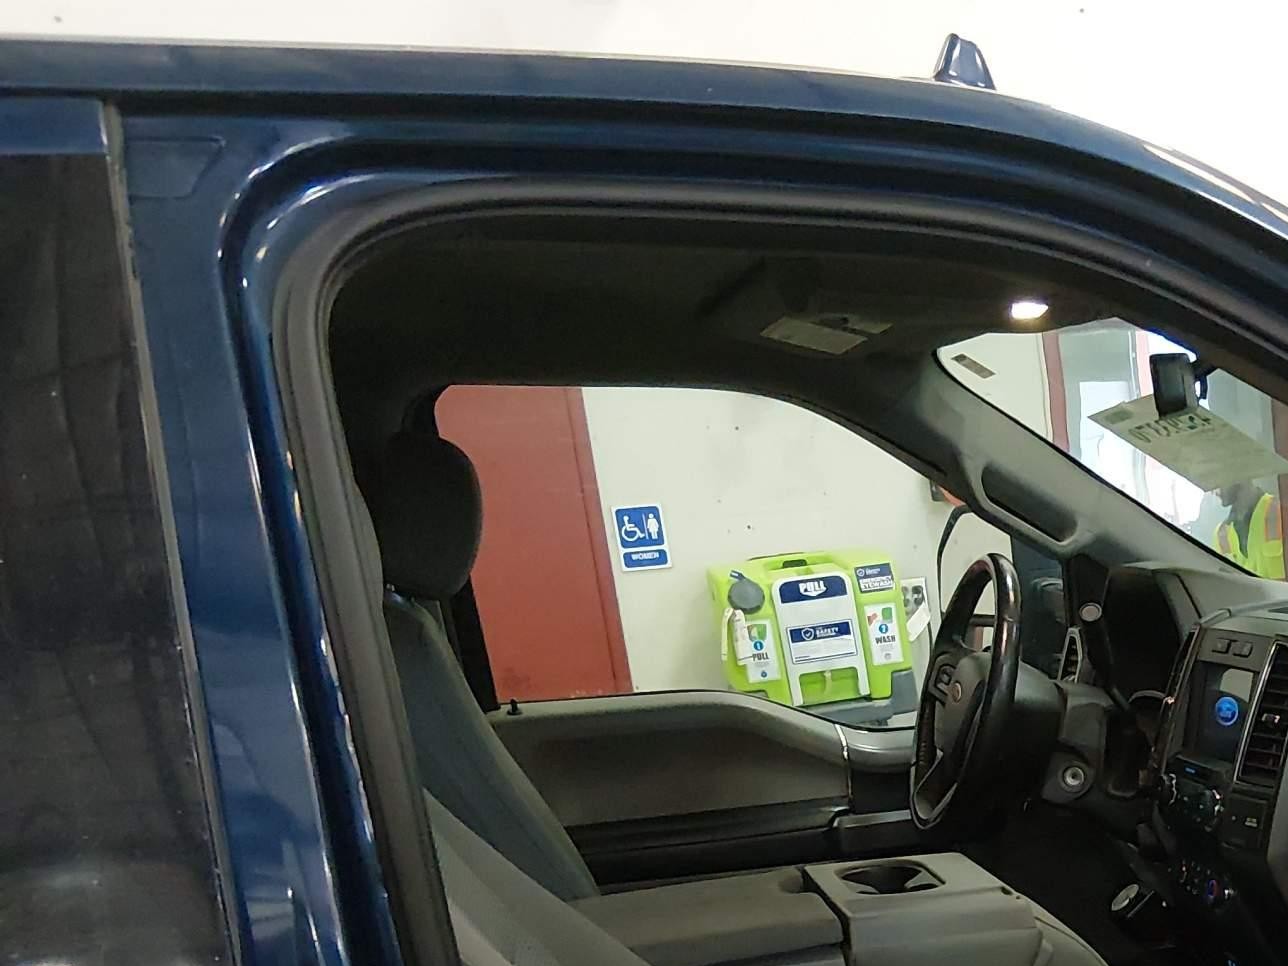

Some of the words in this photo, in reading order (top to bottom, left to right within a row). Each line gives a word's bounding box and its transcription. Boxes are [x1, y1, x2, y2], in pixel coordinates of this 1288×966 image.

[631, 552, 659, 560] WOMEN
[798, 580, 826, 592] PULL
[875, 635, 896, 644] WASH
[752, 651, 769, 661] PULL
